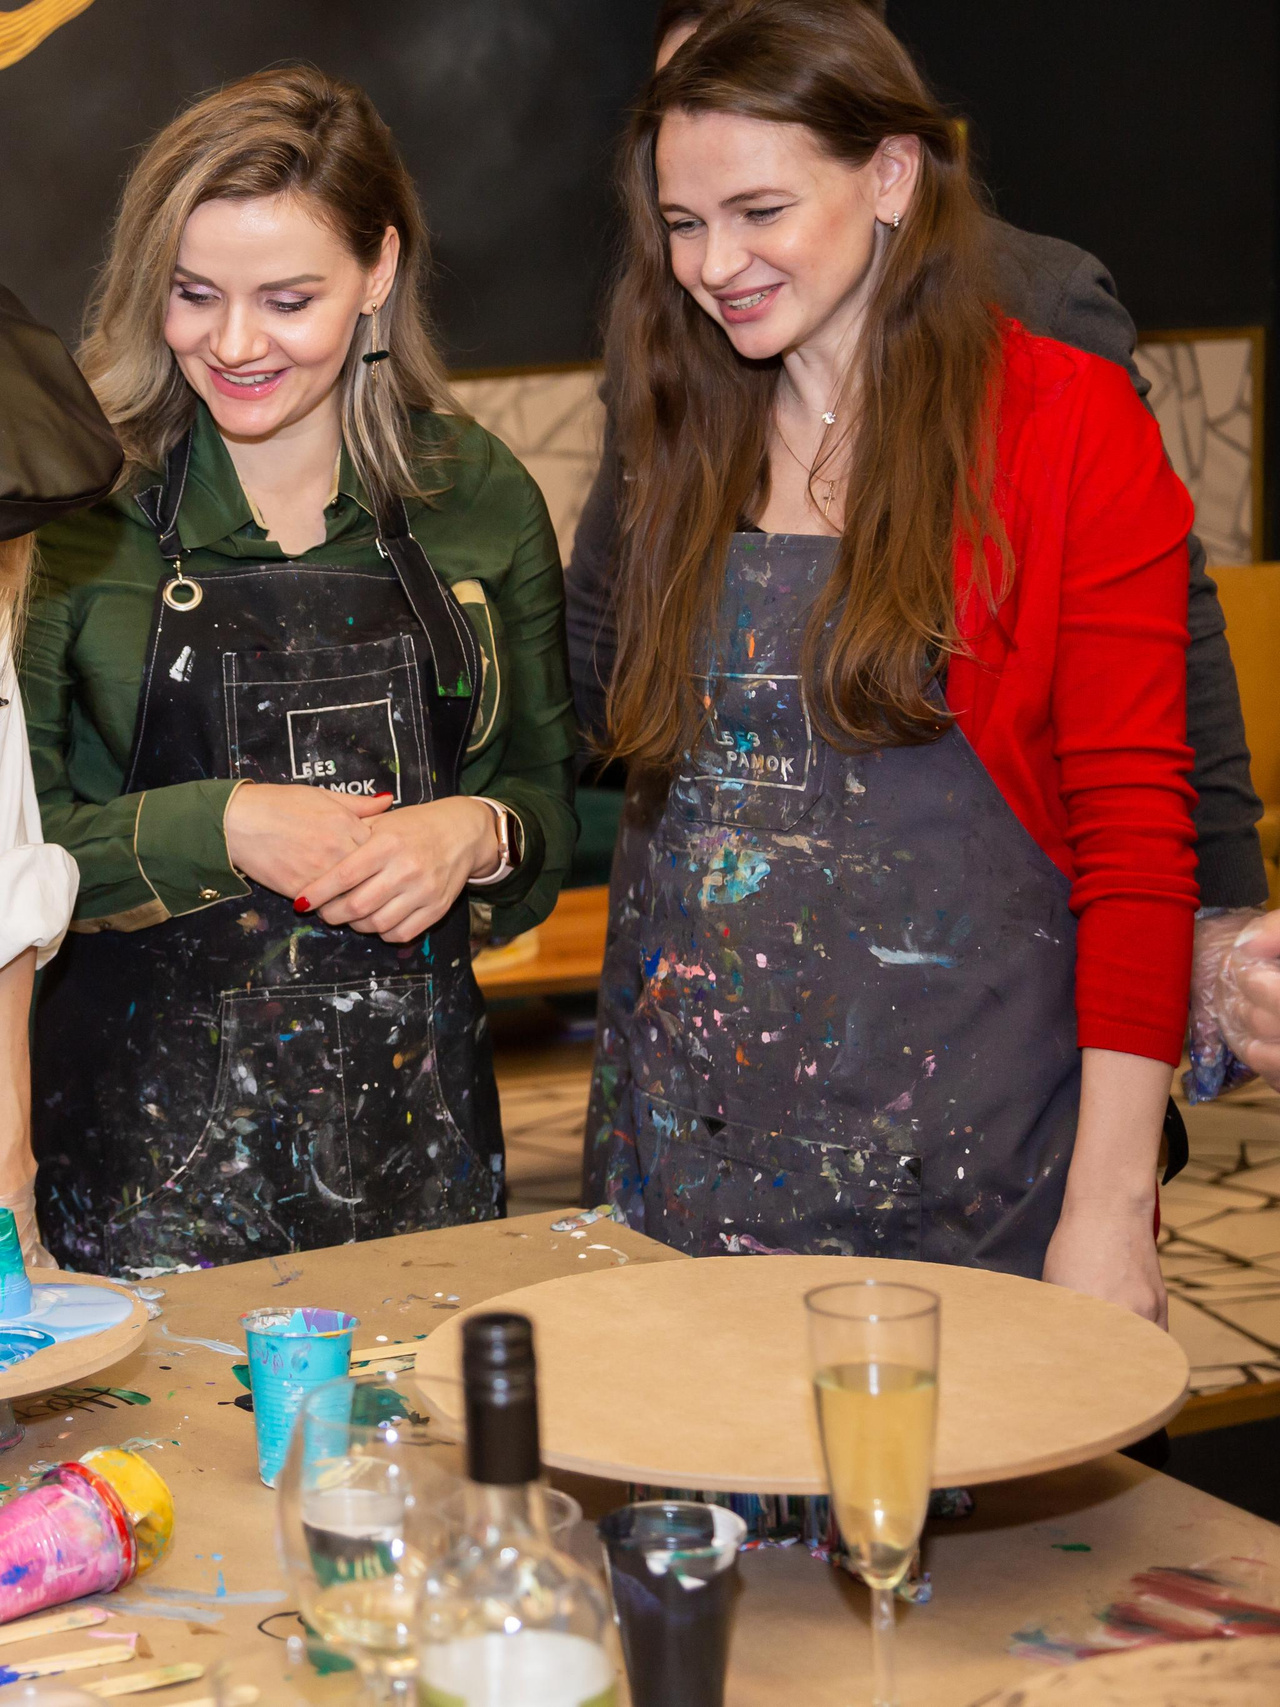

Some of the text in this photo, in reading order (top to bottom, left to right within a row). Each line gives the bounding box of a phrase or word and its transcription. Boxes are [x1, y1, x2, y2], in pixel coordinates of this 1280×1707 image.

[721, 731, 761, 748] БЗ
[301, 759, 337, 777] БЕЗ
[726, 750, 795, 775] РАМОК
